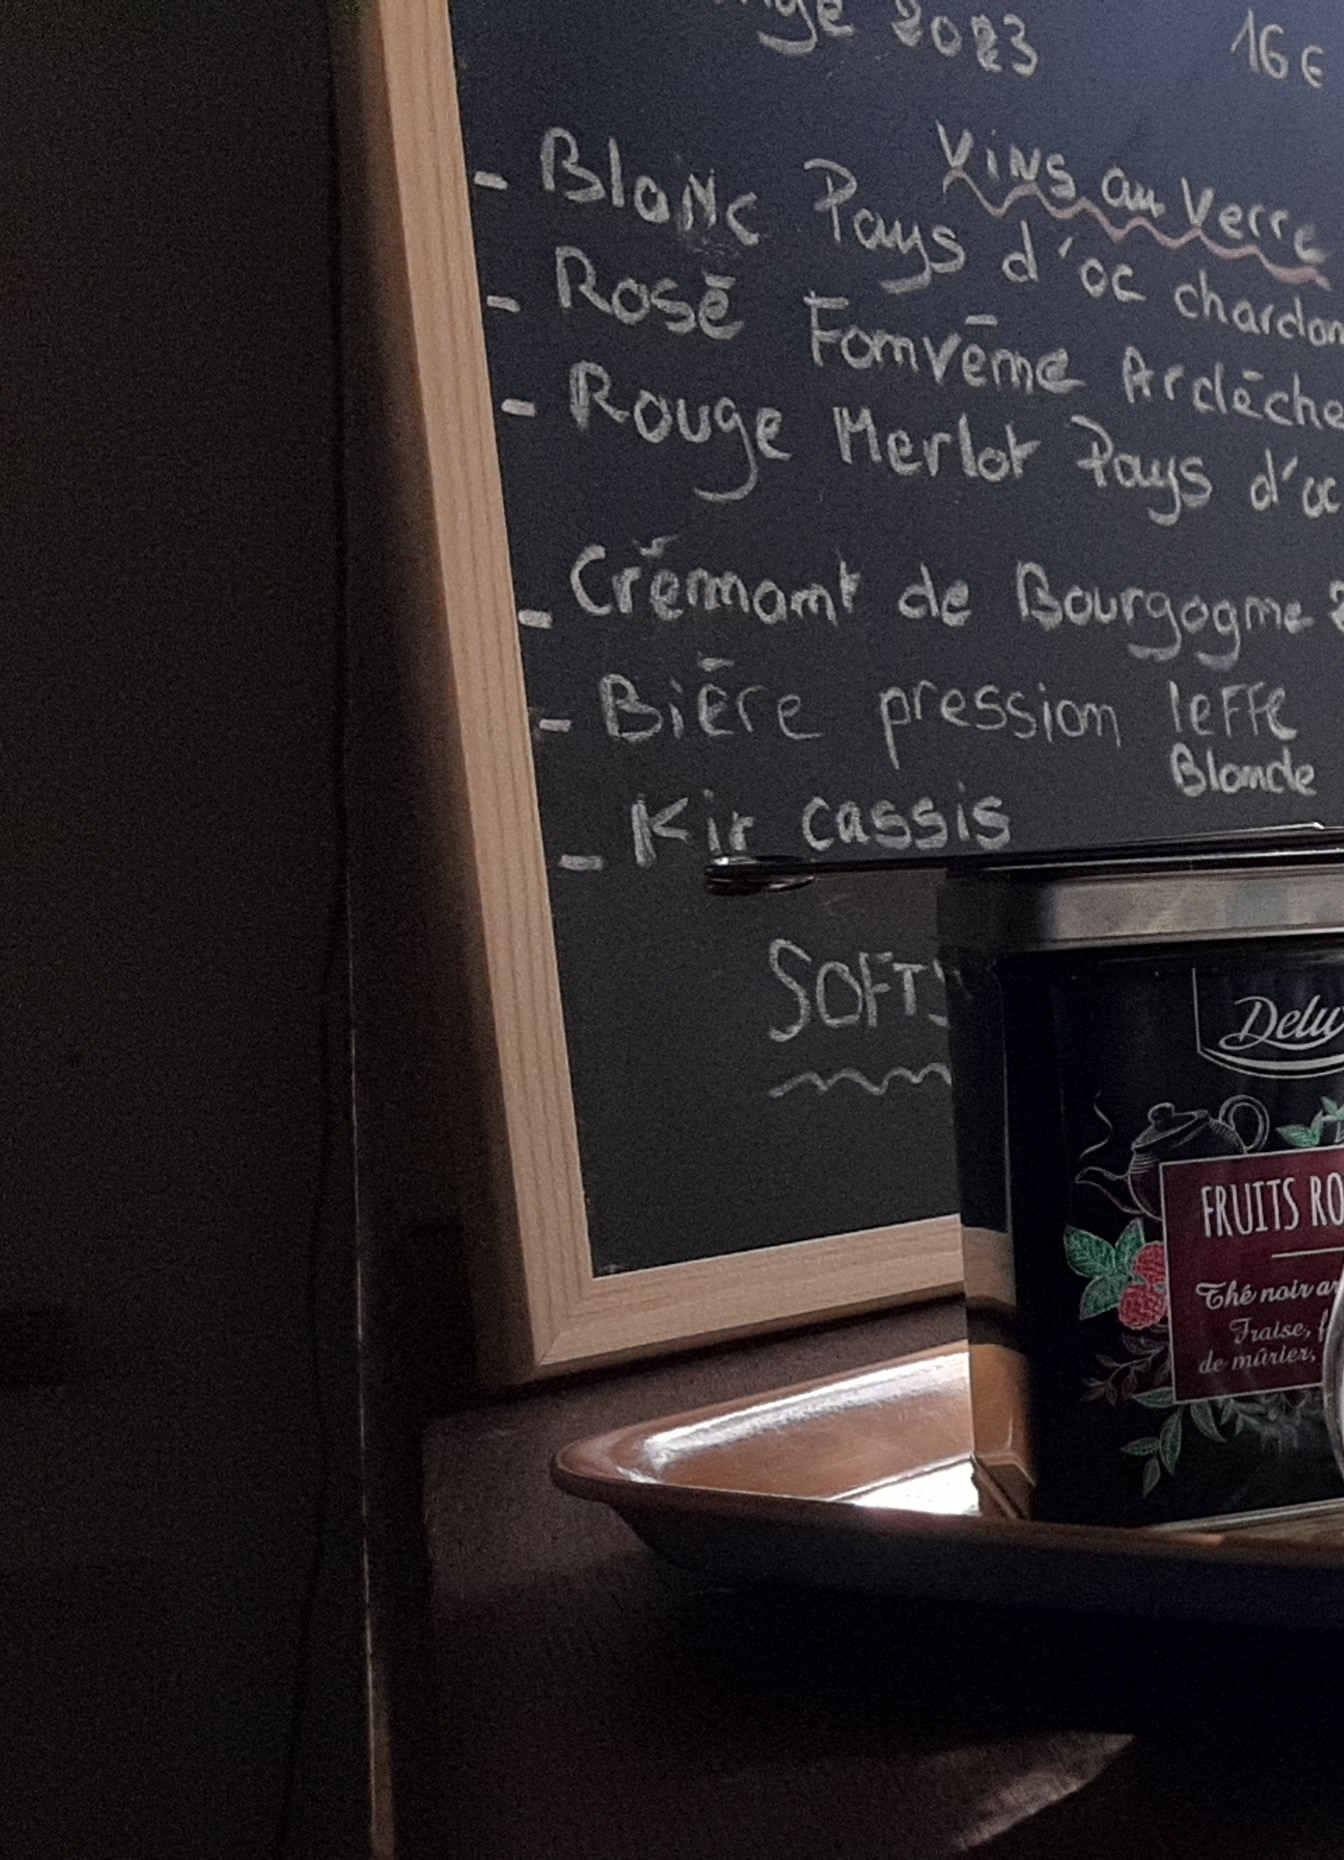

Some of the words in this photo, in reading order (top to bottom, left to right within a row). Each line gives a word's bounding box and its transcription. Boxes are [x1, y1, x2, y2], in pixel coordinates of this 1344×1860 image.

[1101, 168, 1164, 218] au
[803, 157, 966, 294] Pays
[569, 360, 791, 501] Rouge
[834, 406, 1041, 482] Merlot
[1070, 415, 1213, 526] Pays
[898, 563, 971, 626] de
[1016, 561, 1314, 671] Bourgogne
[601, 652, 823, 740] Bière
[879, 679, 1121, 770] pression
[1170, 743, 1317, 797] Blonde
[631, 788, 754, 868] Kir
[801, 780, 1011, 853] cassis
[1201, 1177, 1299, 1238] FRUITS
[1196, 1280, 1257, 1310] Thé
[1260, 1280, 1313, 1303] noir
[1229, 1317, 1311, 1344] Fraise,
[1199, 1350, 1226, 1374] de
